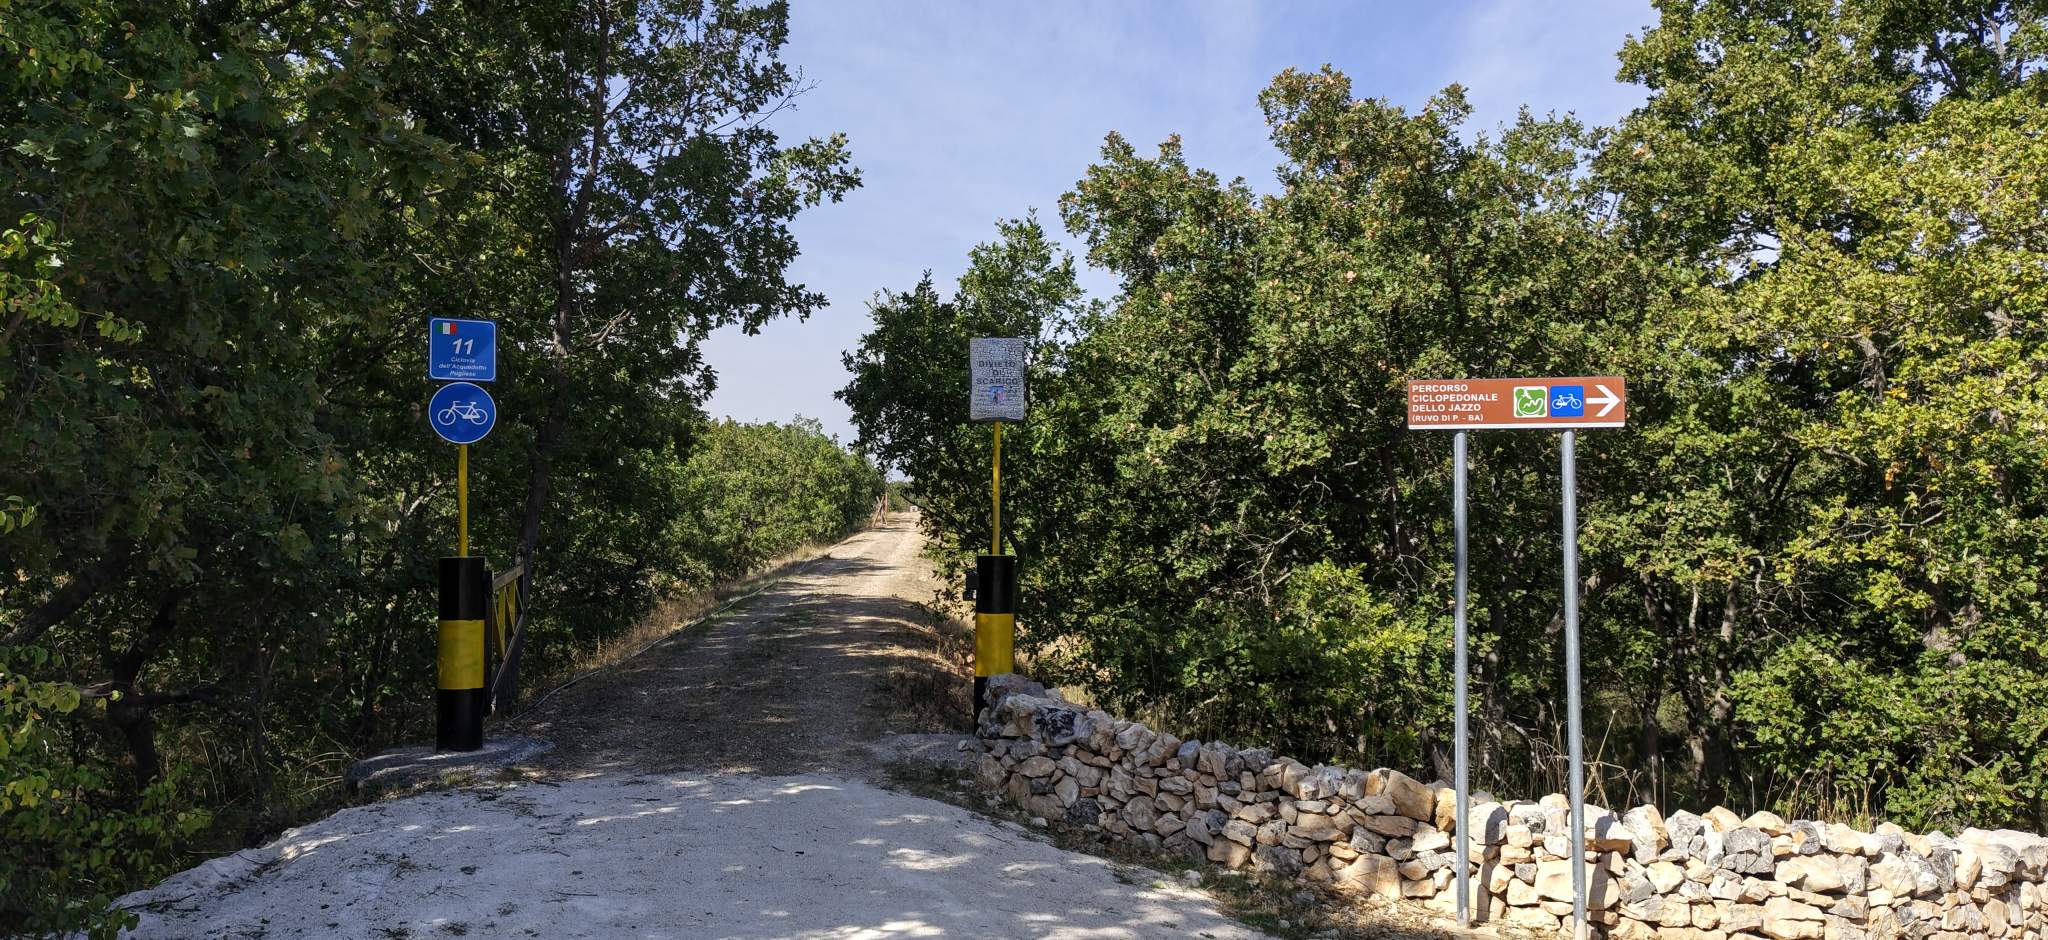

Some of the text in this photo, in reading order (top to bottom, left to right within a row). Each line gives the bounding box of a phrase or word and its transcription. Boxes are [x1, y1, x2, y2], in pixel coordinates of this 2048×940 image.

[453, 338, 474, 355] 11
[978, 360, 1016, 368] DIVIETO
[1412, 384, 1469, 393] PERCORSO
[1412, 393, 1498, 402] CICLOPEDONALE
[1412, 403, 1482, 412] DELLO JAZZO
[1441, 414, 1451, 422] DI
[1452, 414, 1460, 422] P.
[1468, 413, 1484, 422] BA)
